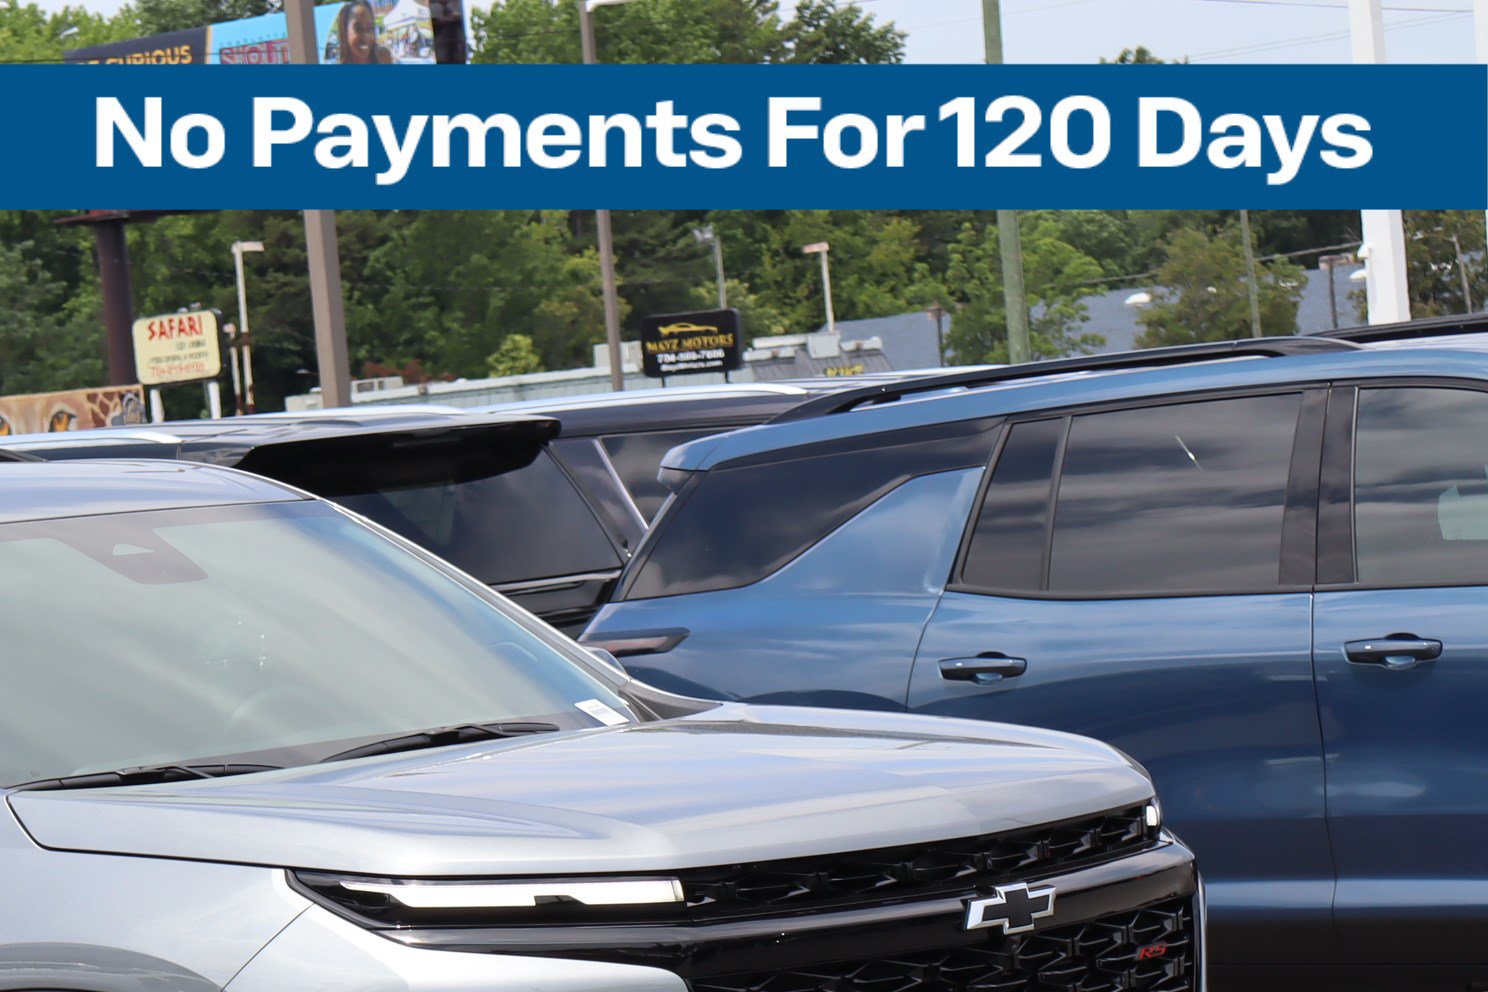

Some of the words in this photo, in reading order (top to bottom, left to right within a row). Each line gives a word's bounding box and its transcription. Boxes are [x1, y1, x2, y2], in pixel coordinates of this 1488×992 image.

[147, 315, 203, 340] SAFARI
[681, 333, 734, 351] MOTORS
[1136, 943, 1168, 961] RS
